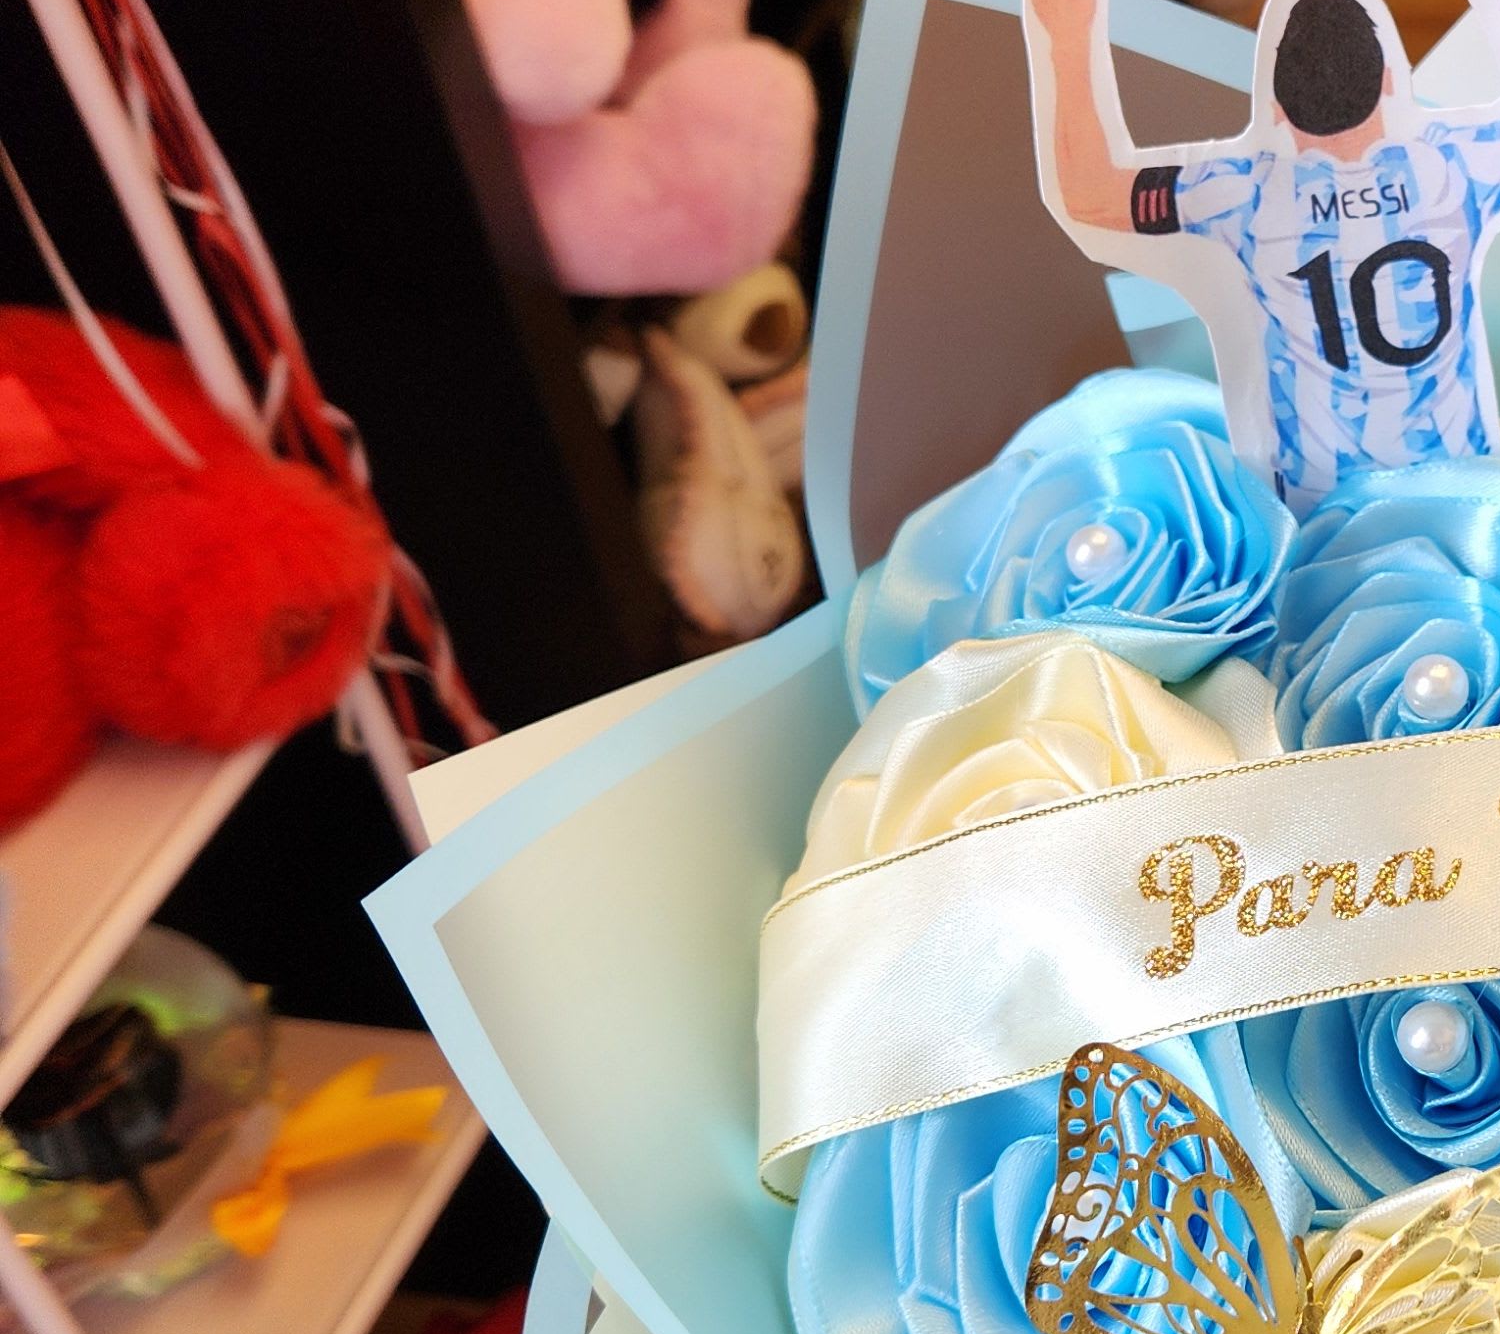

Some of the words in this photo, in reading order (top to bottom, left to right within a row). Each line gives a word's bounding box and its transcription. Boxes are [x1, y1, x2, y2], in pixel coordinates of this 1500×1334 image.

[1310, 183, 1410, 224] MESSI
[1286, 239, 1453, 373] 10
[1137, 833, 1463, 981] Para
